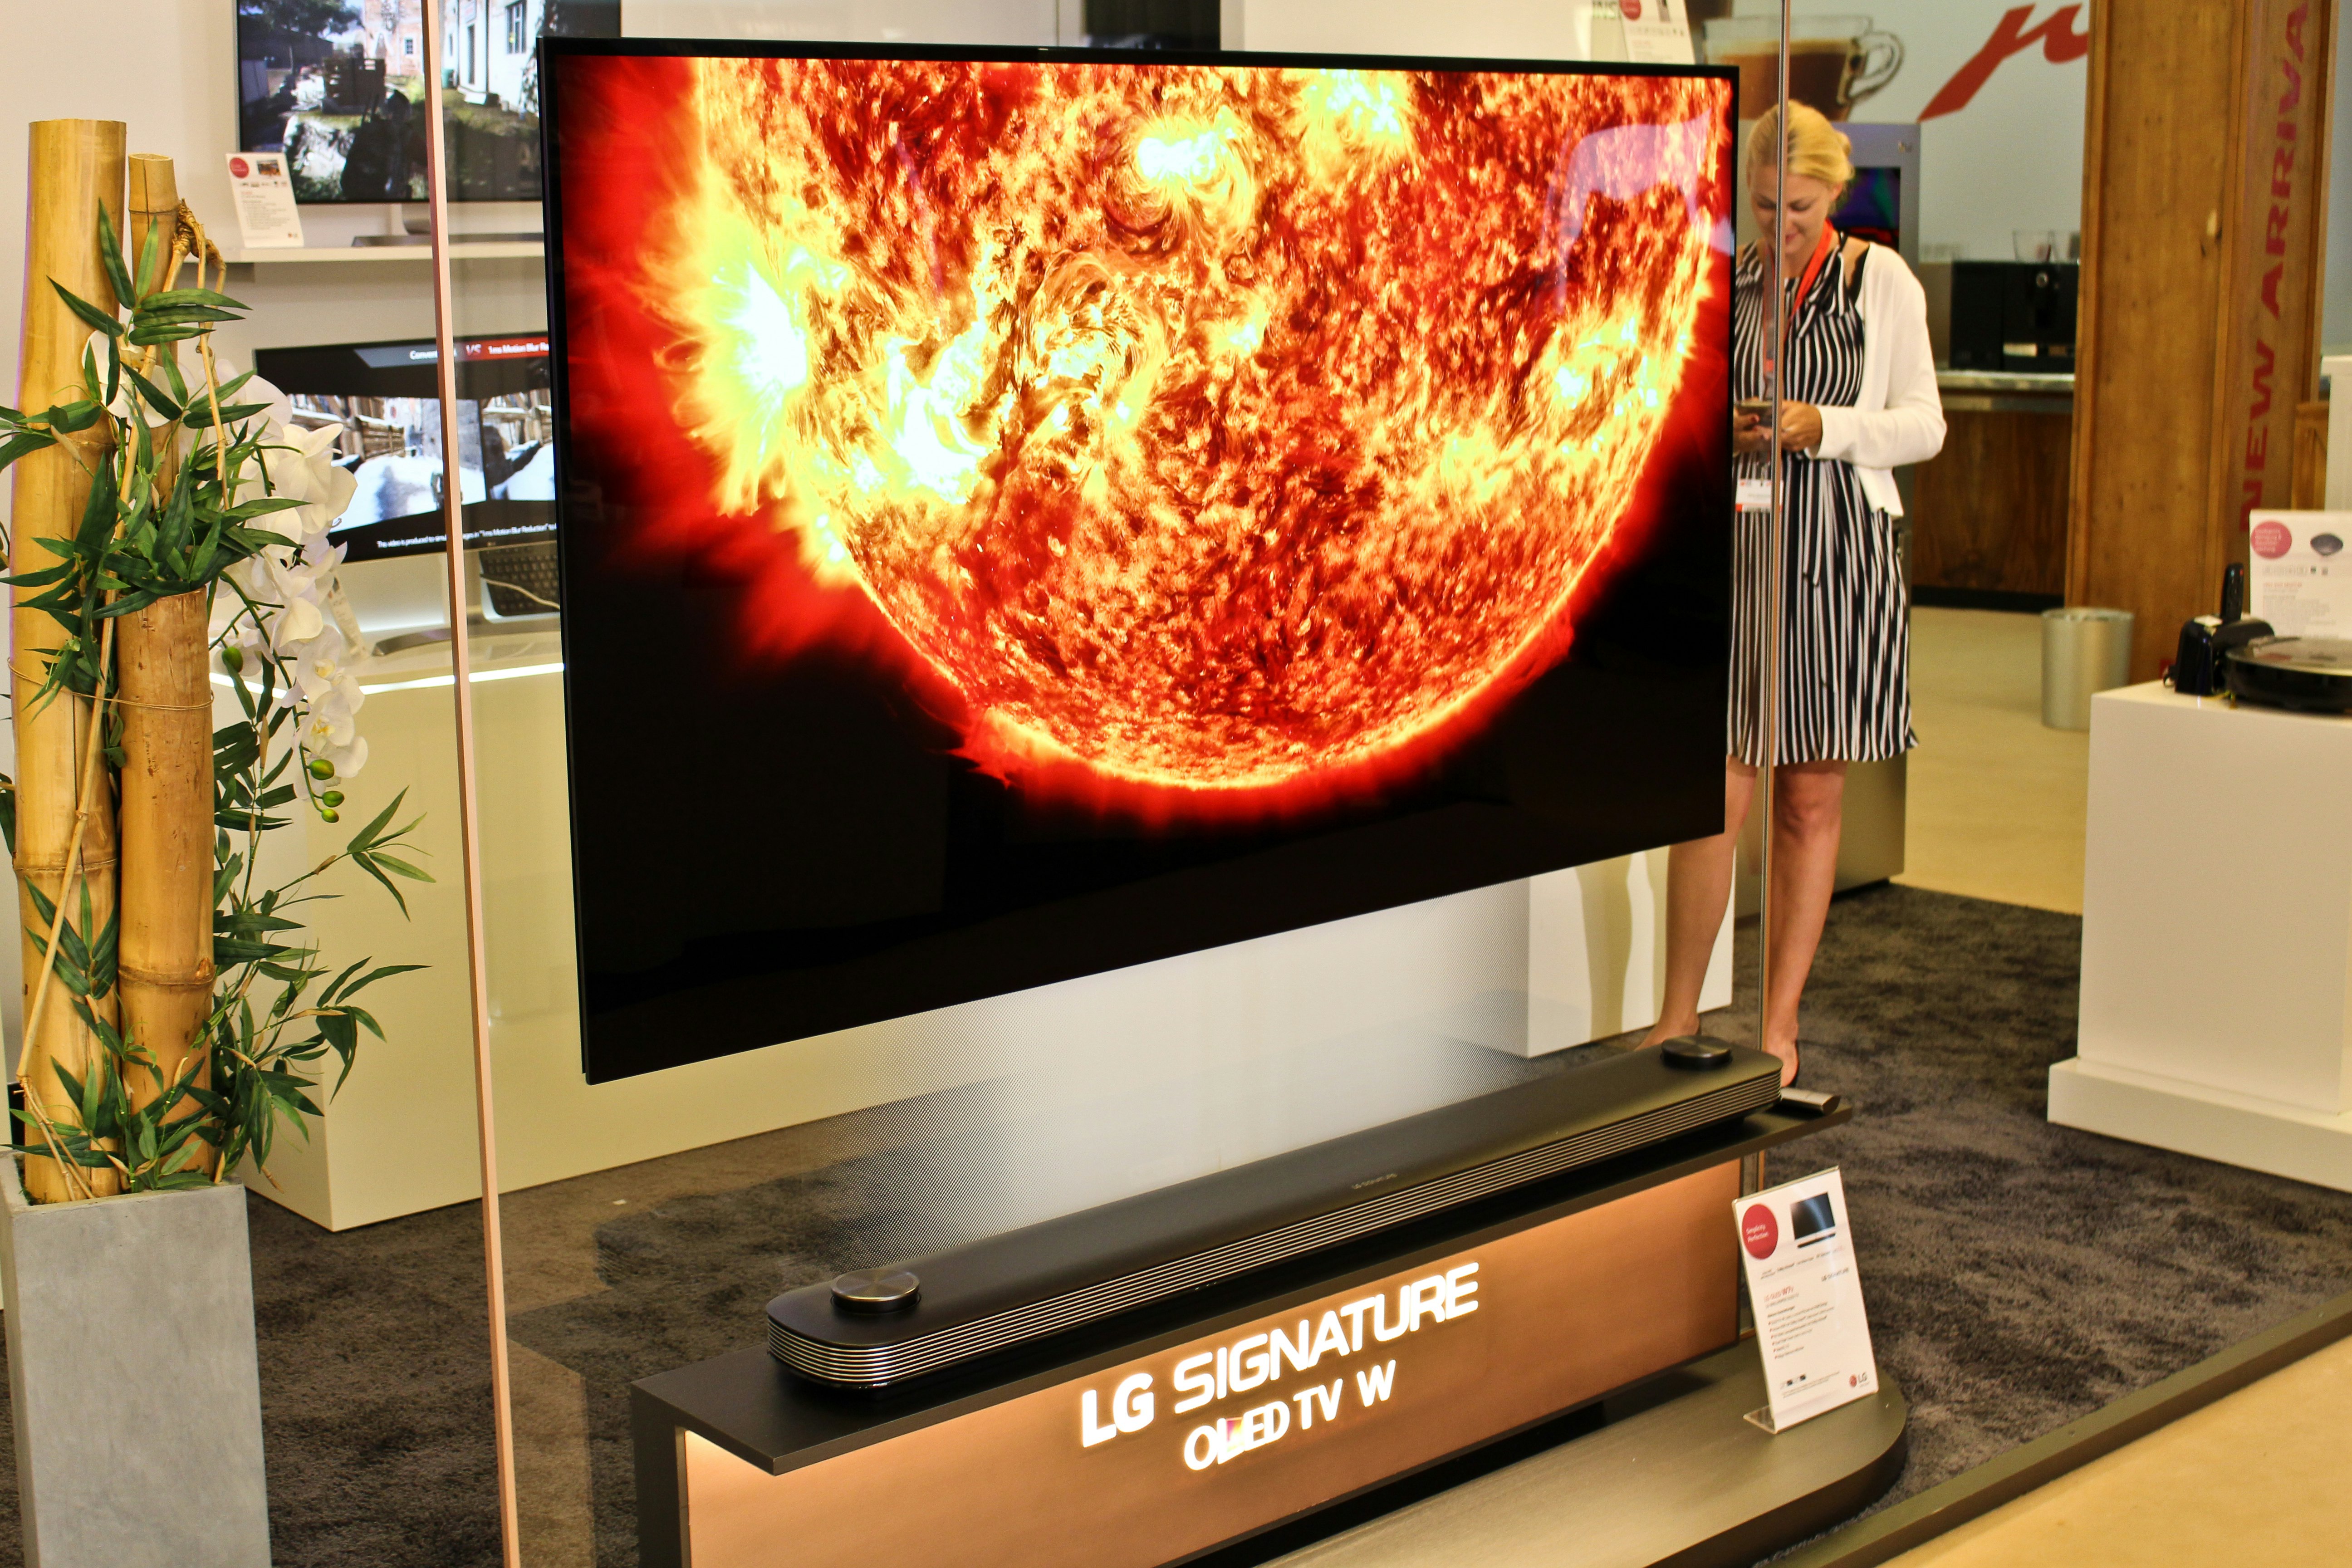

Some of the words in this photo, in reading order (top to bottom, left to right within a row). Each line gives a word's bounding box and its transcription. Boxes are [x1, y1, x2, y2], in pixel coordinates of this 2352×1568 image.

[466, 344, 481, 356] VS
[502, 343, 526, 354] Motion
[526, 343, 539, 352] Blur
[1083, 1373, 1154, 1447] LG
[1174, 1262, 1479, 1414] SIGNATURE
[1857, 1372, 1868, 1383] LG
[1184, 1401, 1290, 1470] OLED
[1293, 1378, 1343, 1430] TV
[1356, 1359, 1396, 1407] W
